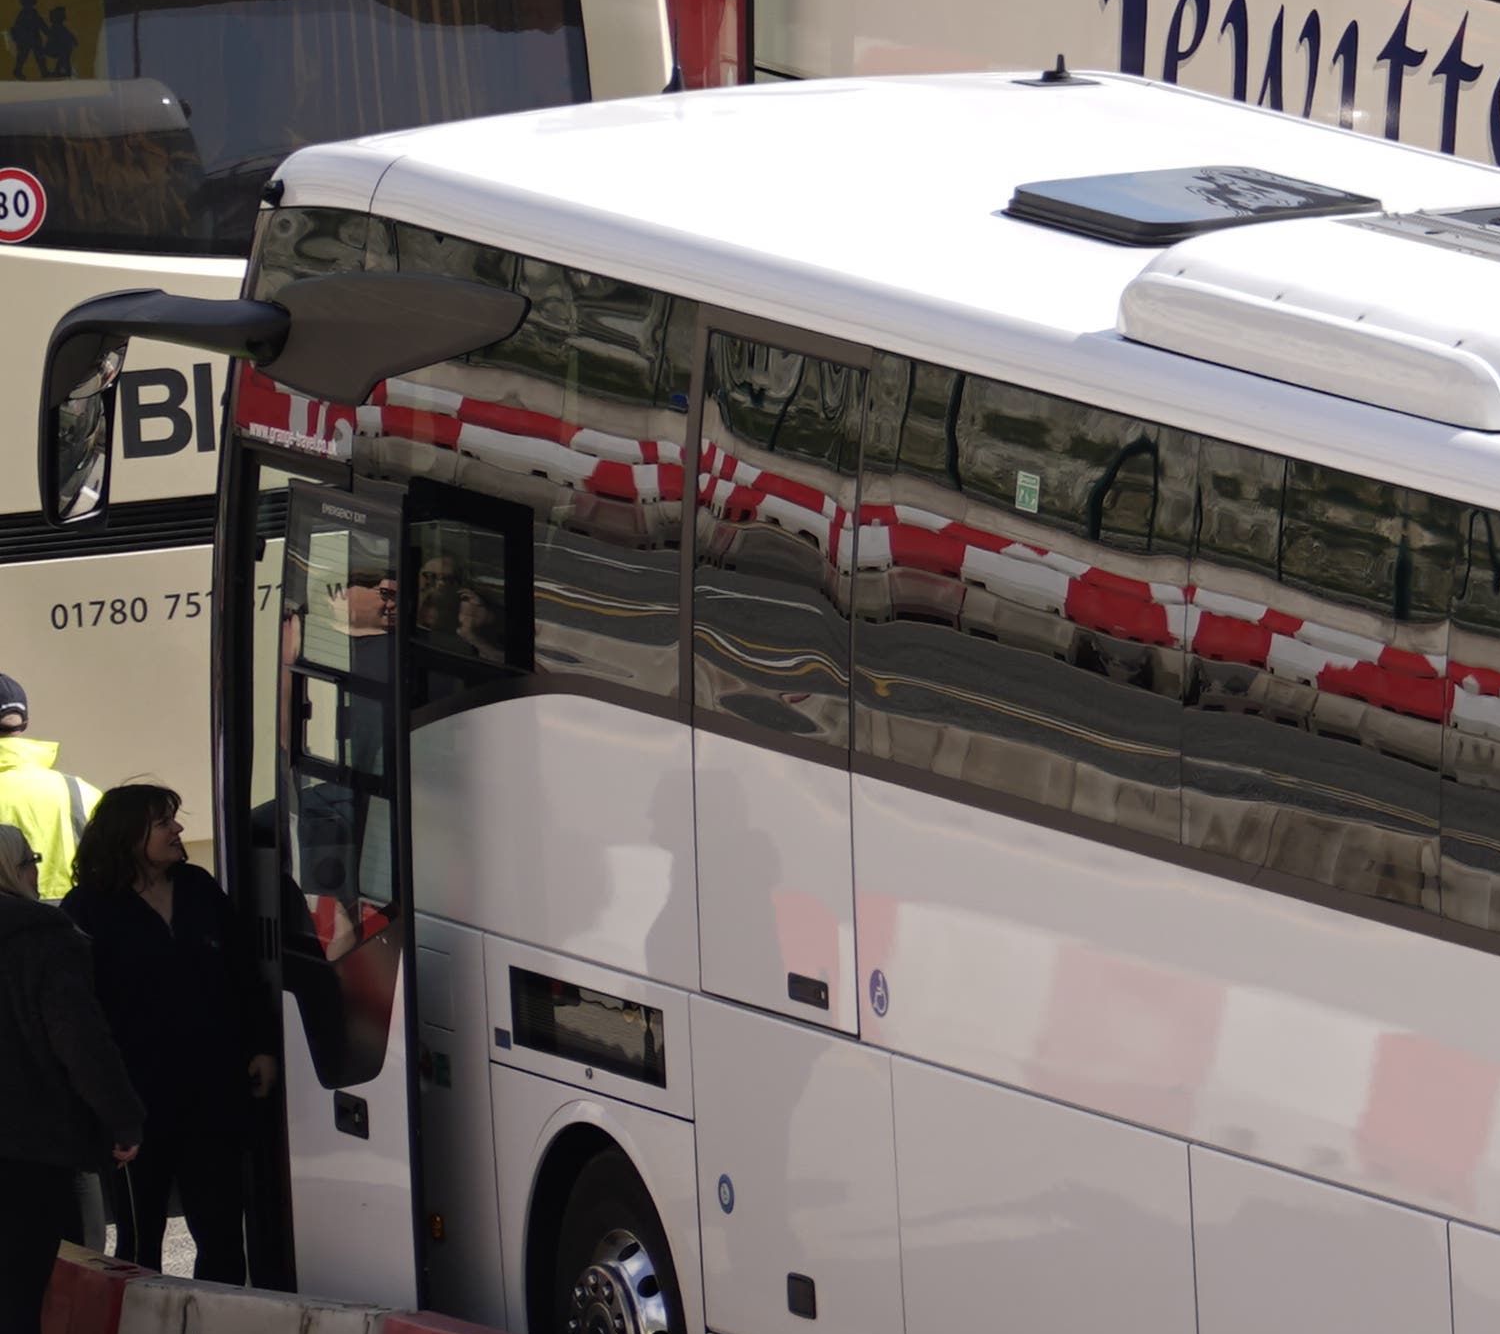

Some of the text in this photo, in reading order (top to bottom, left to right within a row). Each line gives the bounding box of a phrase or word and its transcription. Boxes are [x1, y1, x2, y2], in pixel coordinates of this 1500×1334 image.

[322, 502, 368, 524] EMERGENCY EXIT
[50, 597, 148, 631] 01780
